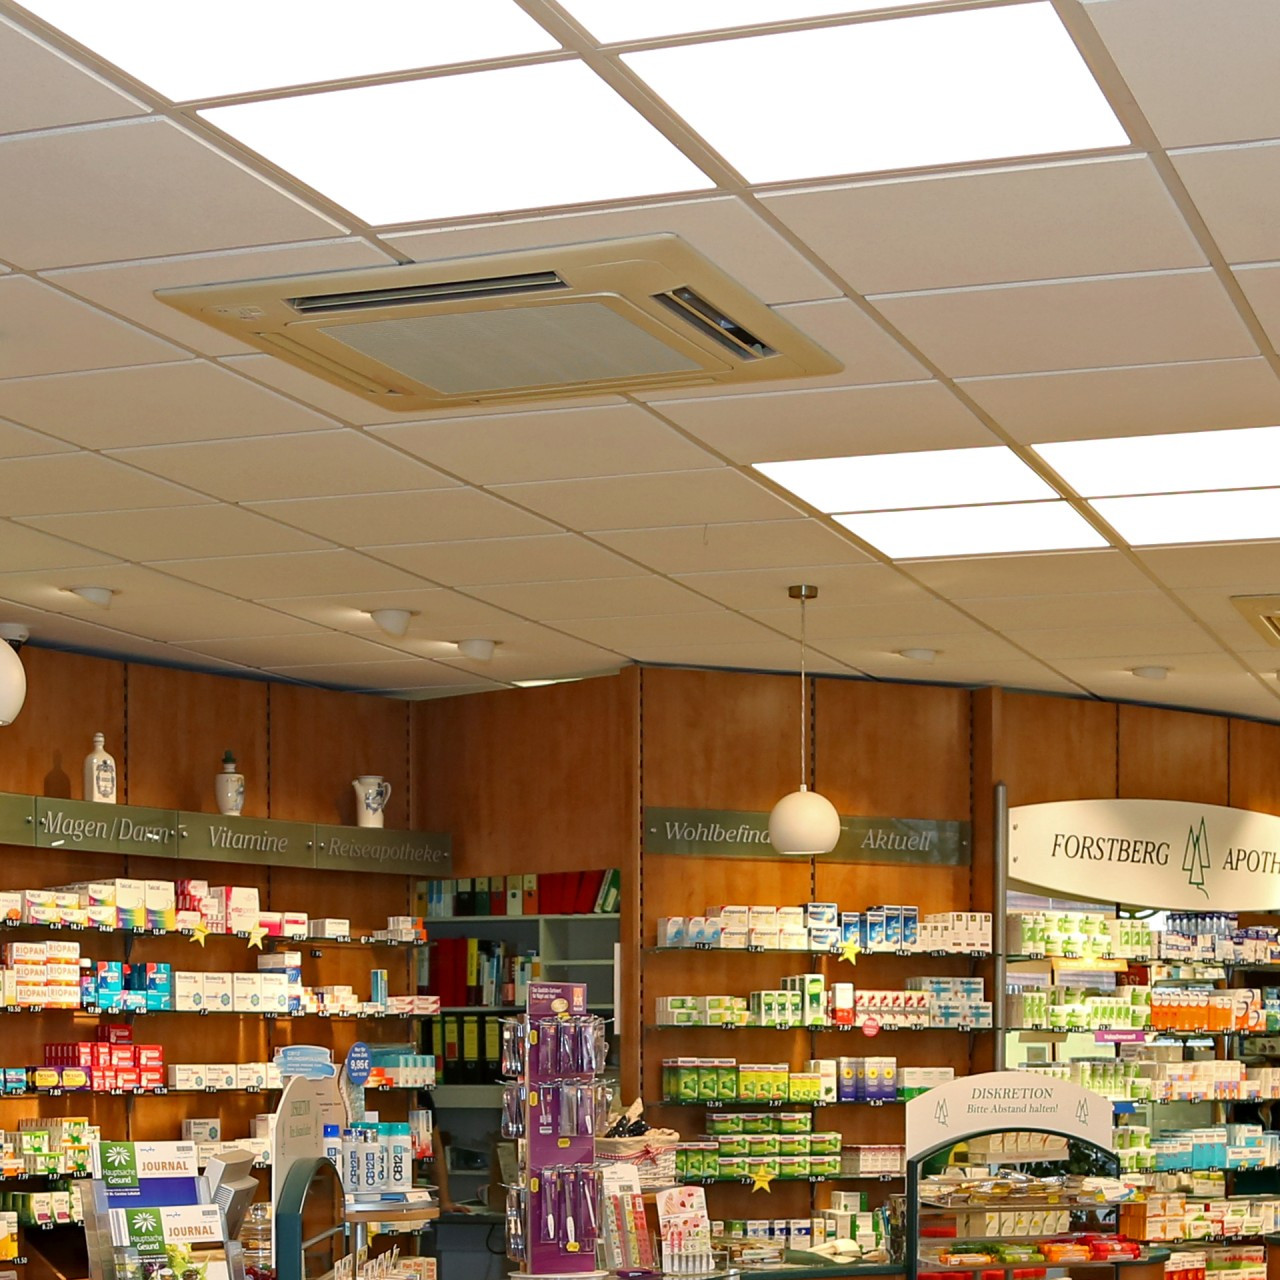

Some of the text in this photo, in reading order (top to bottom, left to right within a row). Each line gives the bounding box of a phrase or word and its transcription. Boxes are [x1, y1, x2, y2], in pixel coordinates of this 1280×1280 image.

[665, 821, 770, 844] Wohlbefin
[209, 826, 288, 853] Vitamine
[861, 828, 932, 852] Aktuell
[328, 836, 443, 865] Reiseapotheke
[1051, 832, 1171, 867] FORSTBERG
[15, 945, 45, 955] RIOPAN
[48, 943, 79, 954] RIOPAN
[16, 967, 46, 977] RIOPAN
[48, 966, 79, 976] RIOPAN
[19, 988, 48, 998] RIOPAN
[49, 988, 79, 998] RIOPAN
[971, 1087, 1054, 1101] DISKRETION
[966, 1102, 1058, 1114] Bitte Abstand halten!
[141, 1161, 189, 1172] JOURNAL
[393, 1153, 403, 1182] CB12
[102, 1168, 136, 1177] Hauptsache
[365, 1159, 375, 1186] CB12
[108, 1175, 132, 1185] Gesund
[168, 1226, 215, 1237] JOURNAL
[130, 1235, 163, 1243] Hauptsache
[136, 1242, 160, 1251] Gesund
